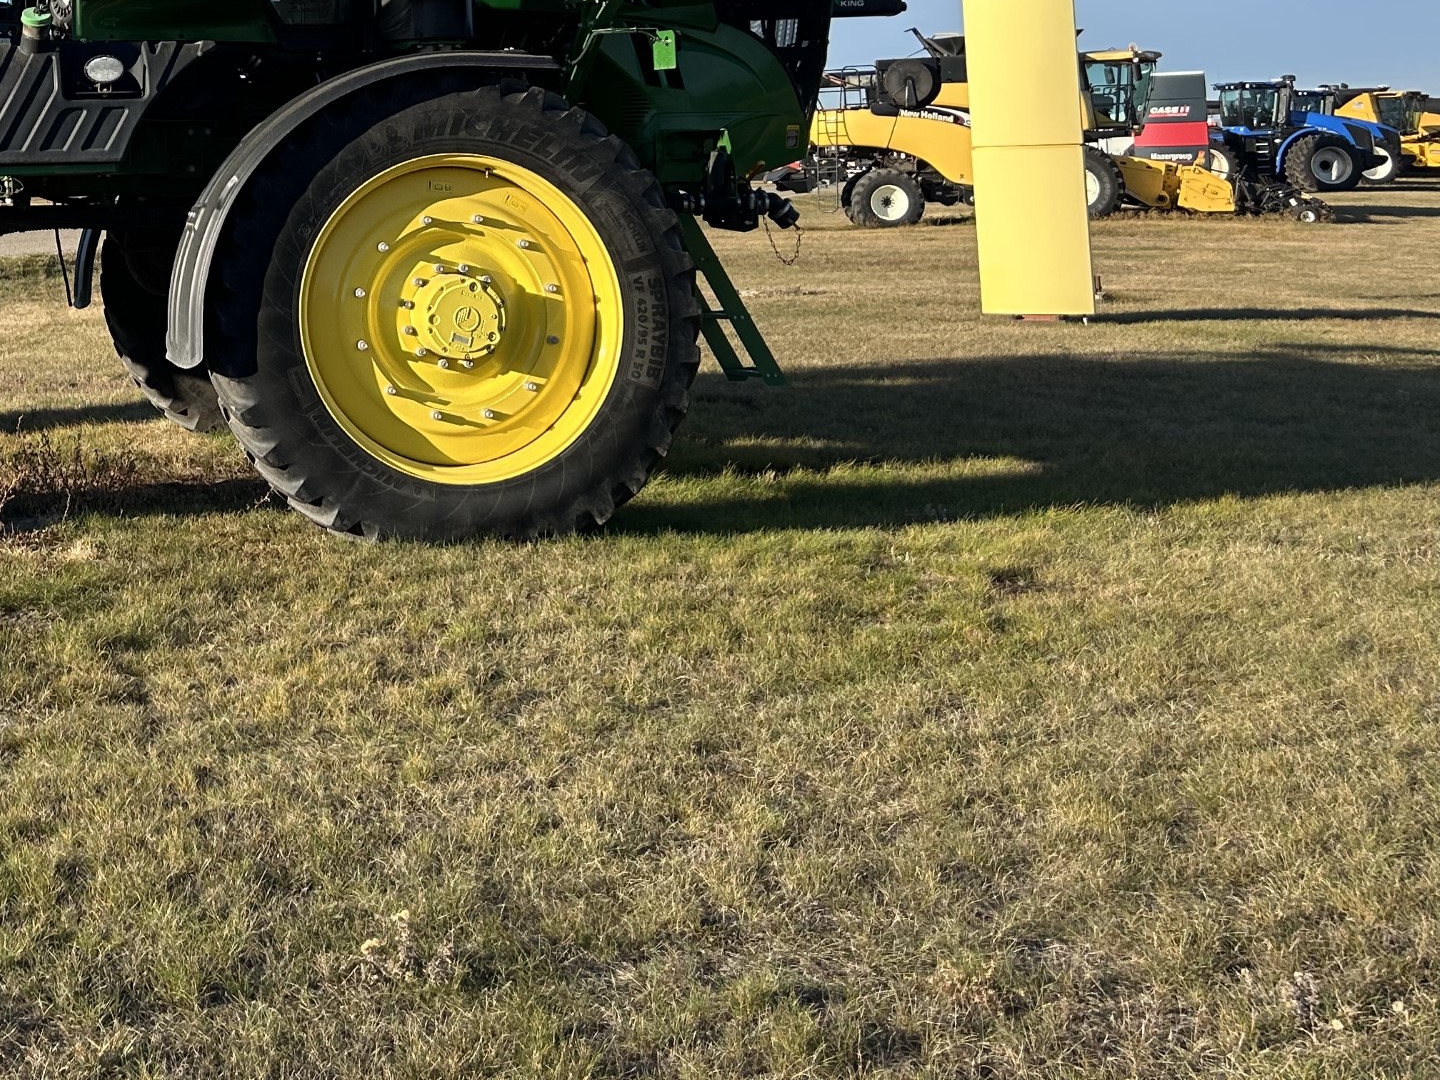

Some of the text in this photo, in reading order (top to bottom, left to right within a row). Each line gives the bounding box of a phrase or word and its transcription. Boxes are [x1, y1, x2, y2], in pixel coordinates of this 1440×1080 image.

[920, 111, 954, 123] Holland
[1149, 106, 1179, 114] CASE
[413, 111, 600, 185] MICHELIN
[1150, 153, 1193, 161] Mazergroup
[620, 209, 648, 252] MICHELIN
[630, 275, 648, 380] VF 420/95 R 50
[645, 276, 667, 381] SPRAYBIB
